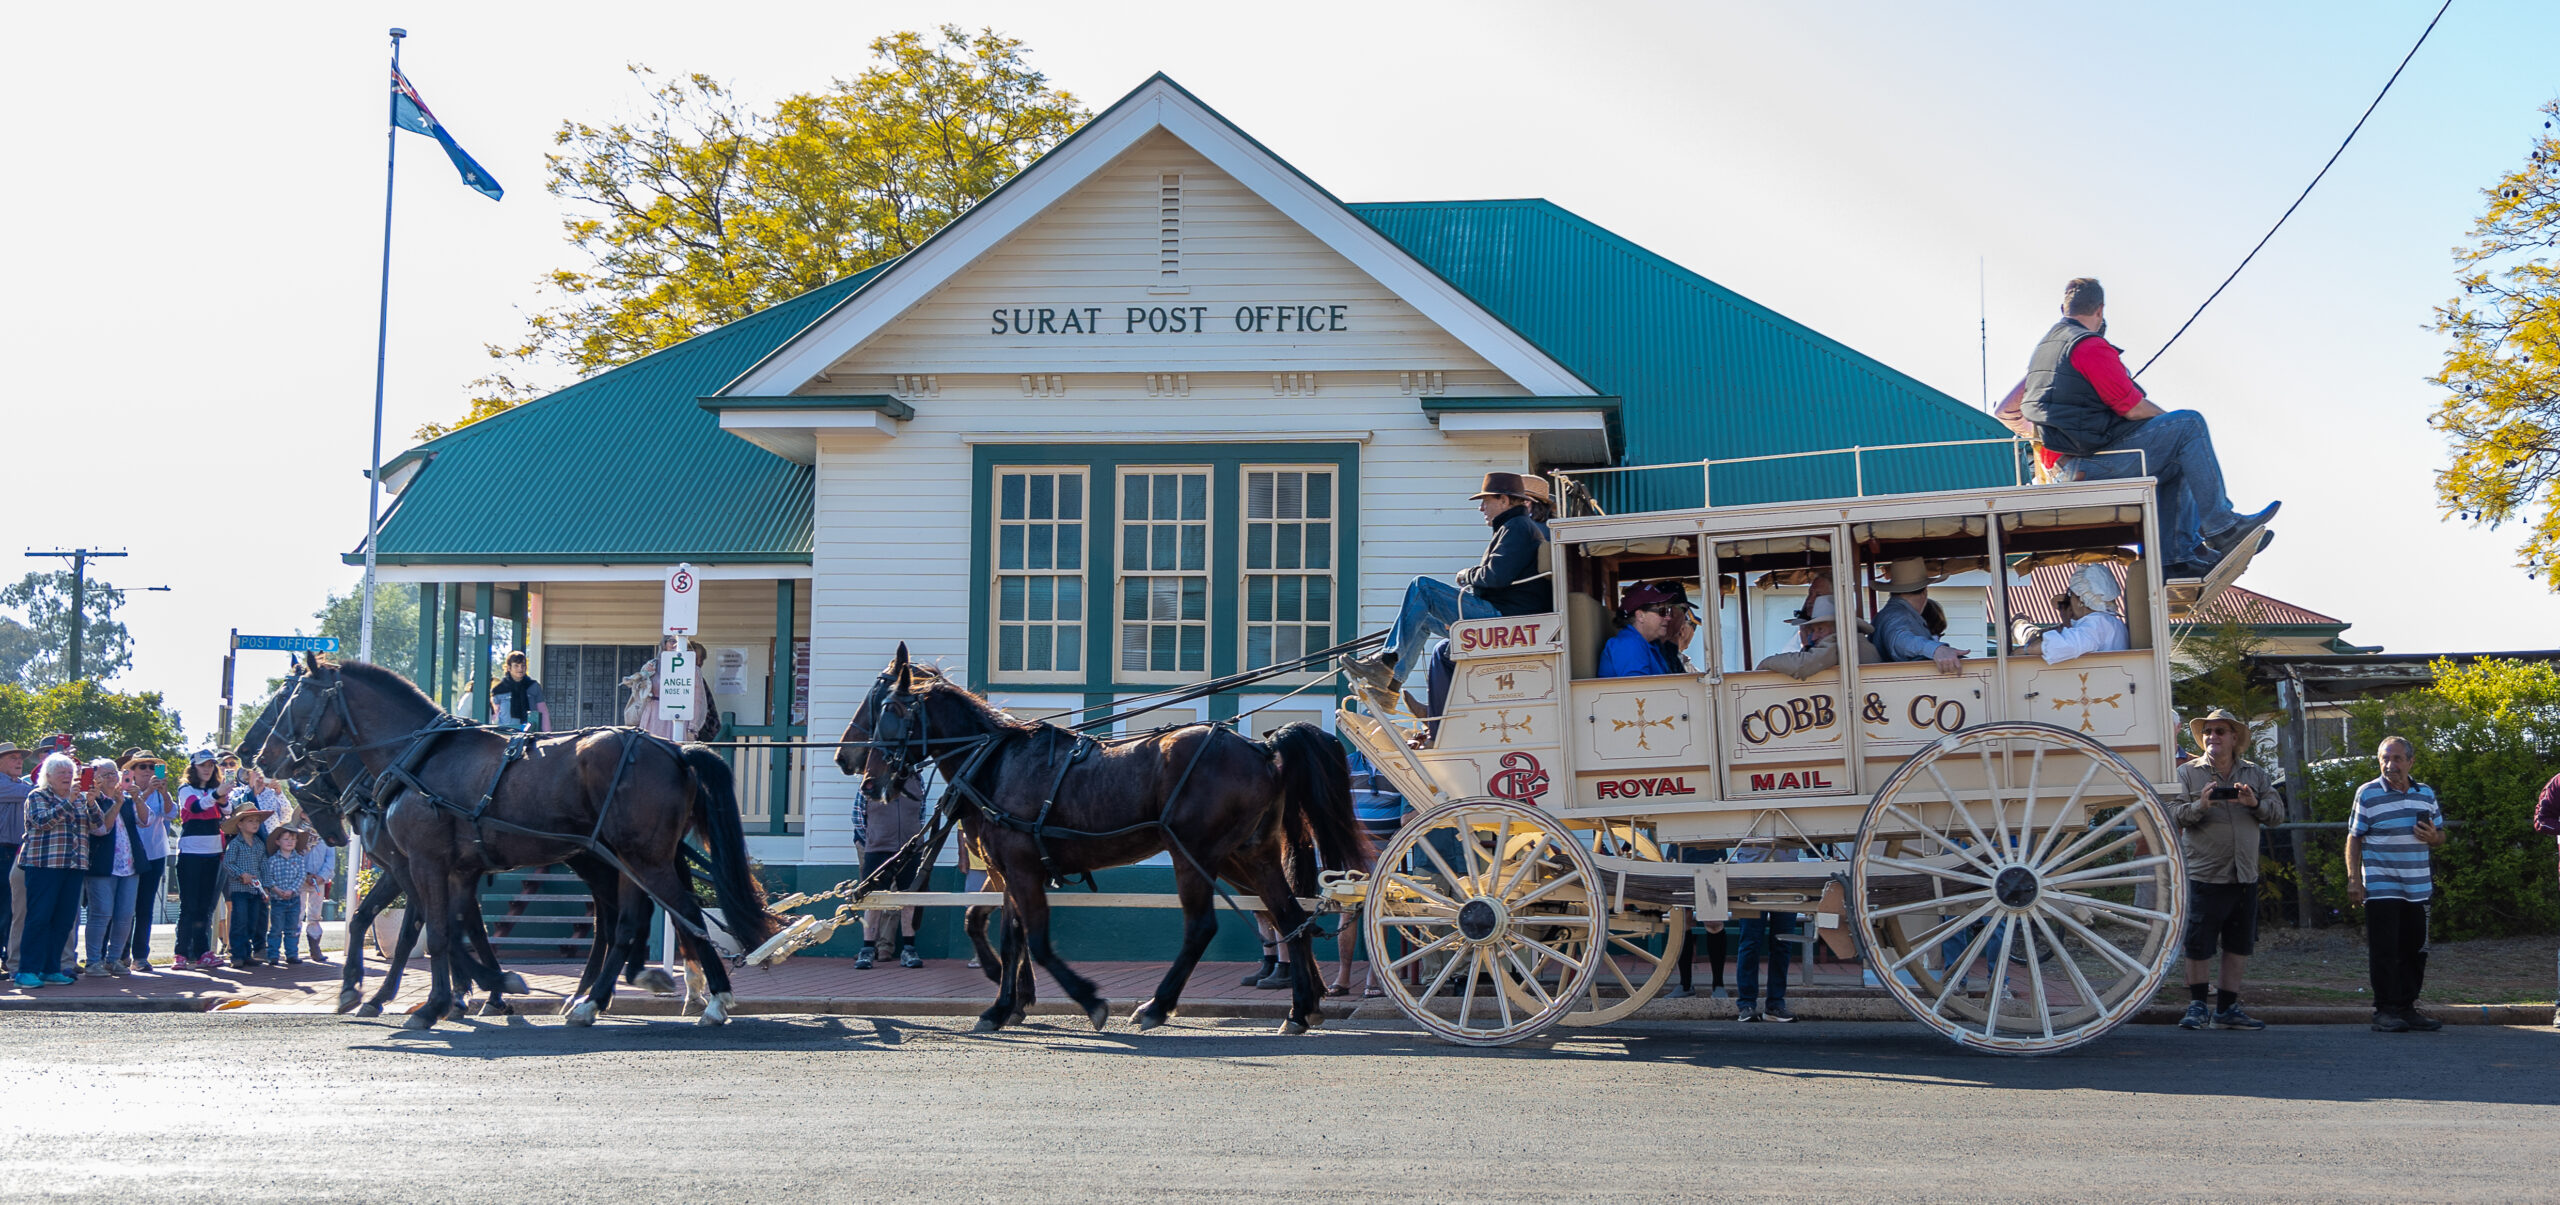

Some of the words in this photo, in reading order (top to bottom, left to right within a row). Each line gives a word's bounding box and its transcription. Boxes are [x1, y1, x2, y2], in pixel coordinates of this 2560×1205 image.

[991, 308, 1102, 335] SURAT
[1126, 306, 1207, 334] POST
[1235, 304, 1348, 332] OFFICE
[241, 637, 271, 648] POST
[279, 638, 321, 650] OFFICE
[1460, 624, 1541, 651] SURAT
[672, 657, 684, 673] P
[663, 678, 692, 687] ANGLE
[1495, 672, 1515, 691] 14
[1741, 694, 1836, 745] COBB
[1861, 692, 1889, 724] &
[1908, 694, 1966, 734] CO
[1597, 777, 1696, 800] ROYAL
[1750, 770, 1832, 791] MAIL
